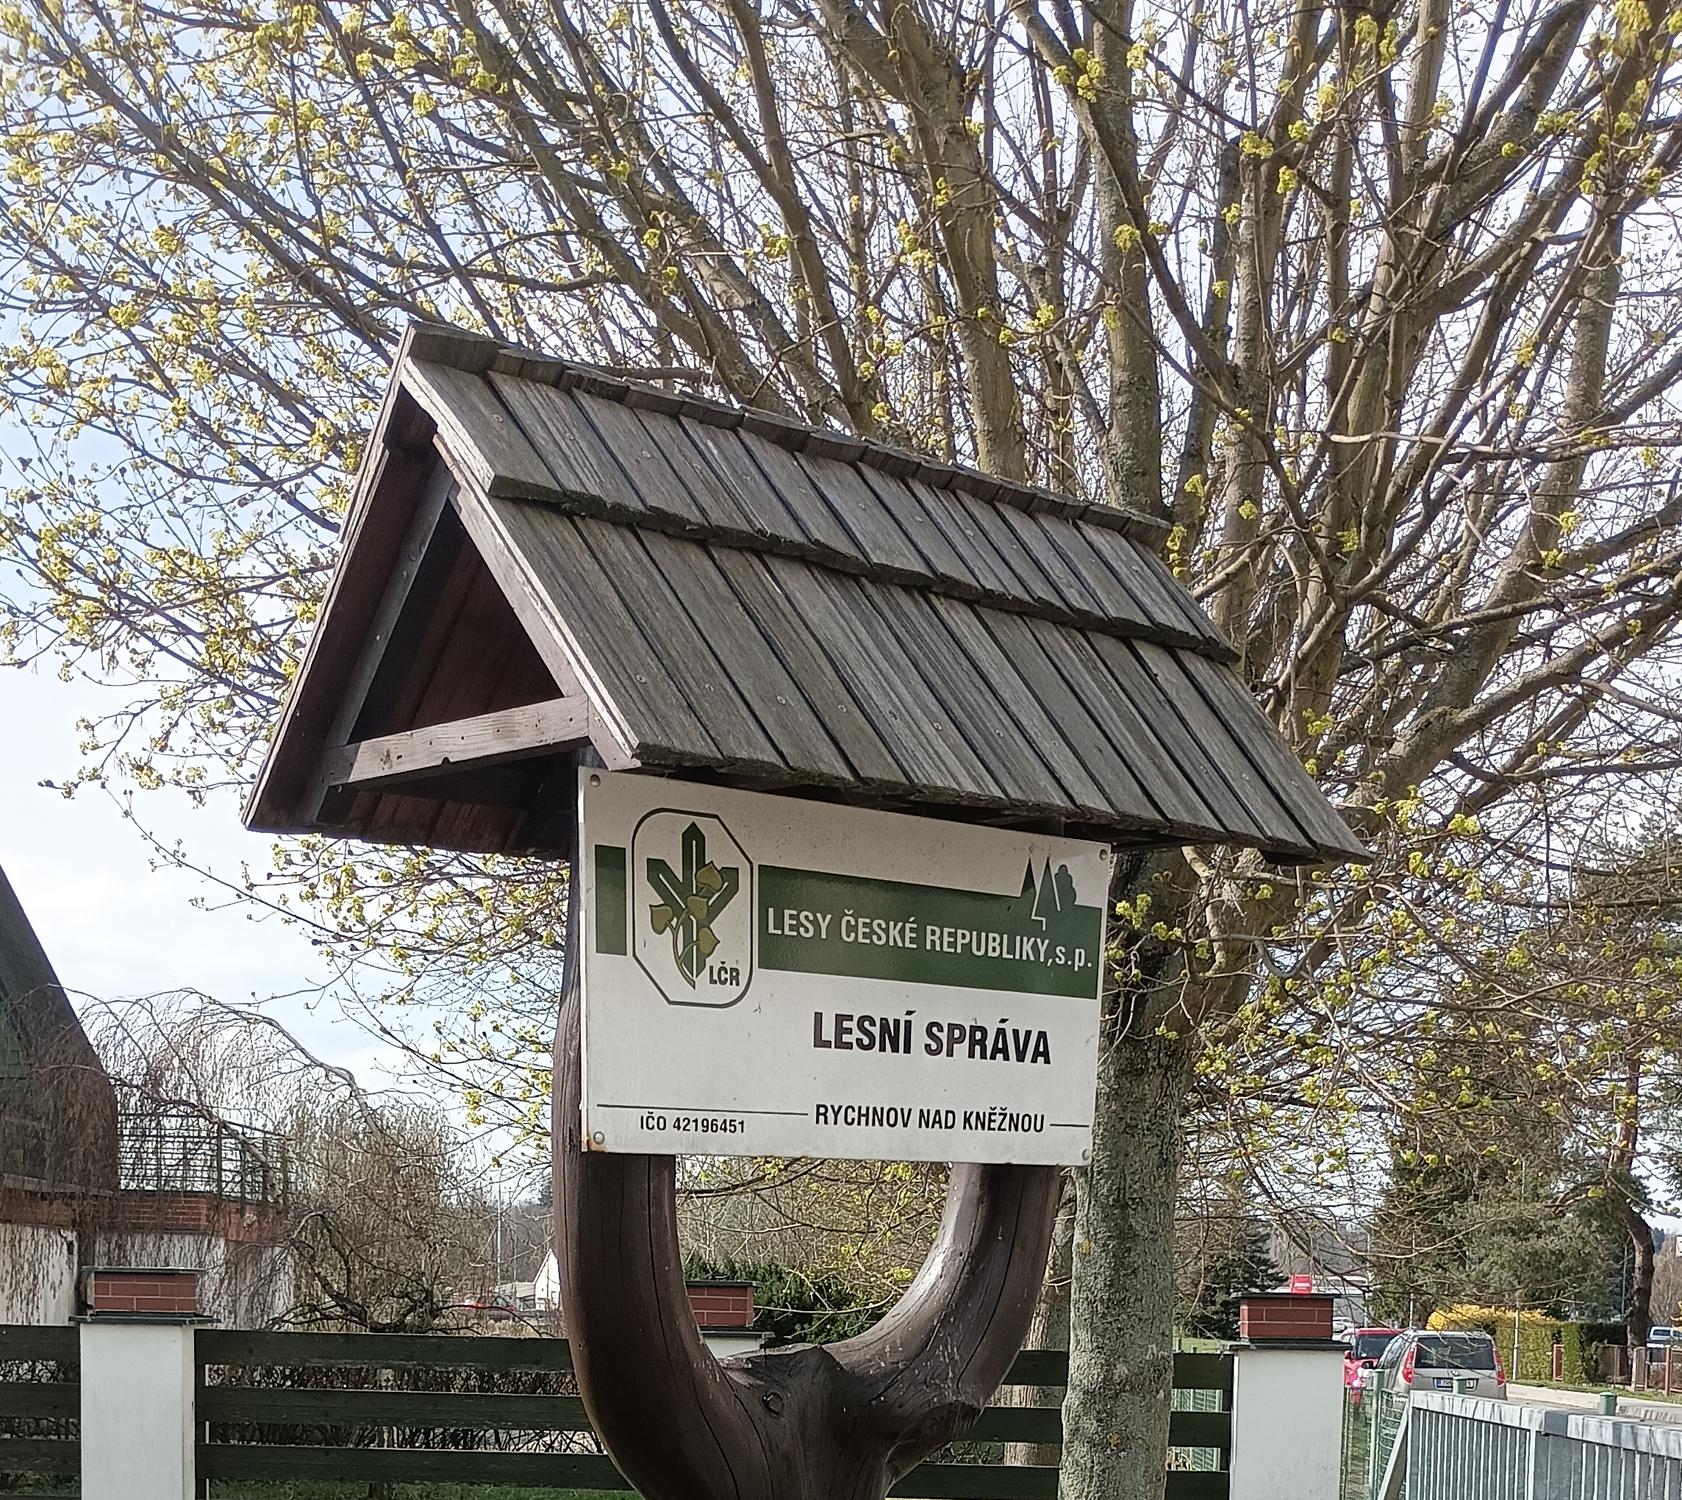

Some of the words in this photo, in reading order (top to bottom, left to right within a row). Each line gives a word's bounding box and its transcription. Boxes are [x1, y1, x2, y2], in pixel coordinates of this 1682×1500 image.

[768, 907, 832, 940] LESY
[840, 909, 918, 948] ČESKÉ
[709, 961, 740, 987] LČR
[813, 1011, 915, 1055] LESNÍ
[924, 1018, 1051, 1065] SPRÁVA
[640, 1113, 667, 1132] IČO
[673, 1119, 745, 1135] 42196451
[814, 1104, 911, 1129] RYCHNOV
[918, 1110, 956, 1130] NAD
[962, 1107, 1045, 1133] KNĚŽNOU
